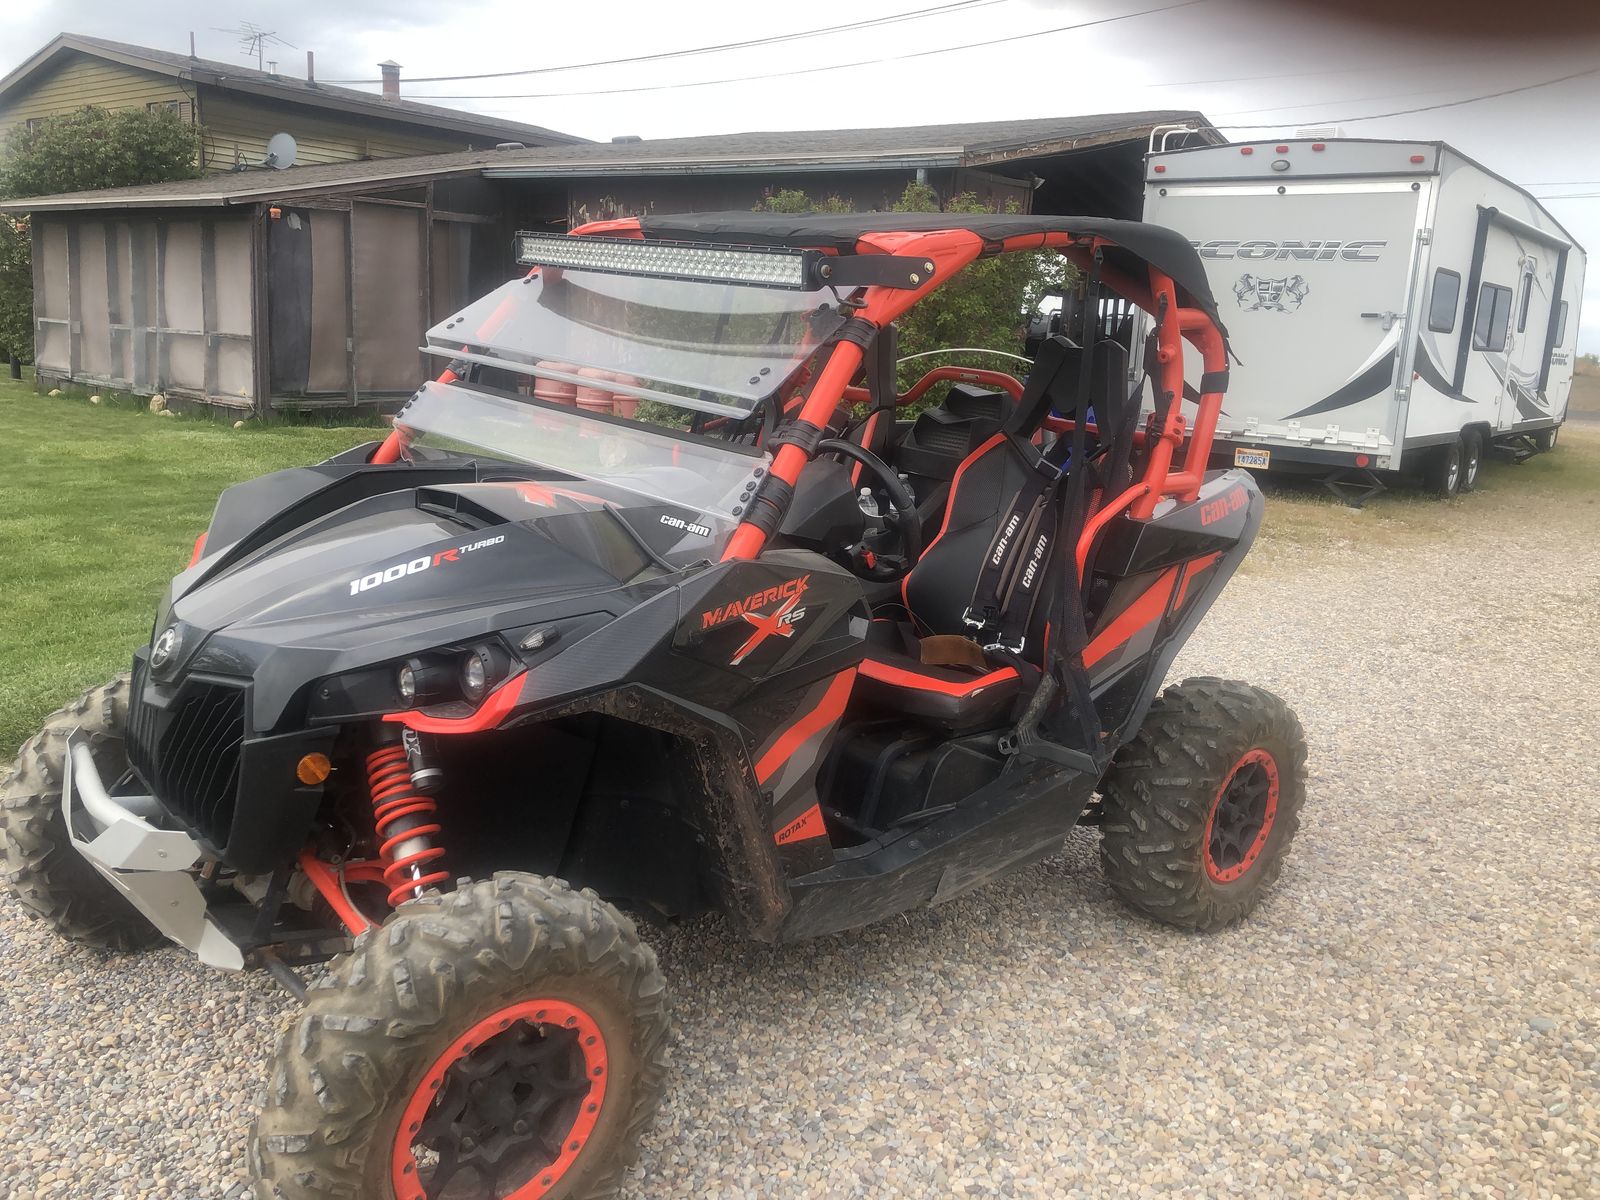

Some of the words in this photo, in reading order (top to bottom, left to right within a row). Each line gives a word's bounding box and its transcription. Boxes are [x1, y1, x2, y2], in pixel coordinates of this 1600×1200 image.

[459, 535, 505, 553] TURBO
[660, 514, 710, 537] can-am
[992, 514, 1020, 565] can-am
[1022, 534, 1048, 588] can-am
[701, 574, 810, 629] MAVERICK
[778, 815, 807, 843] ROTAX
